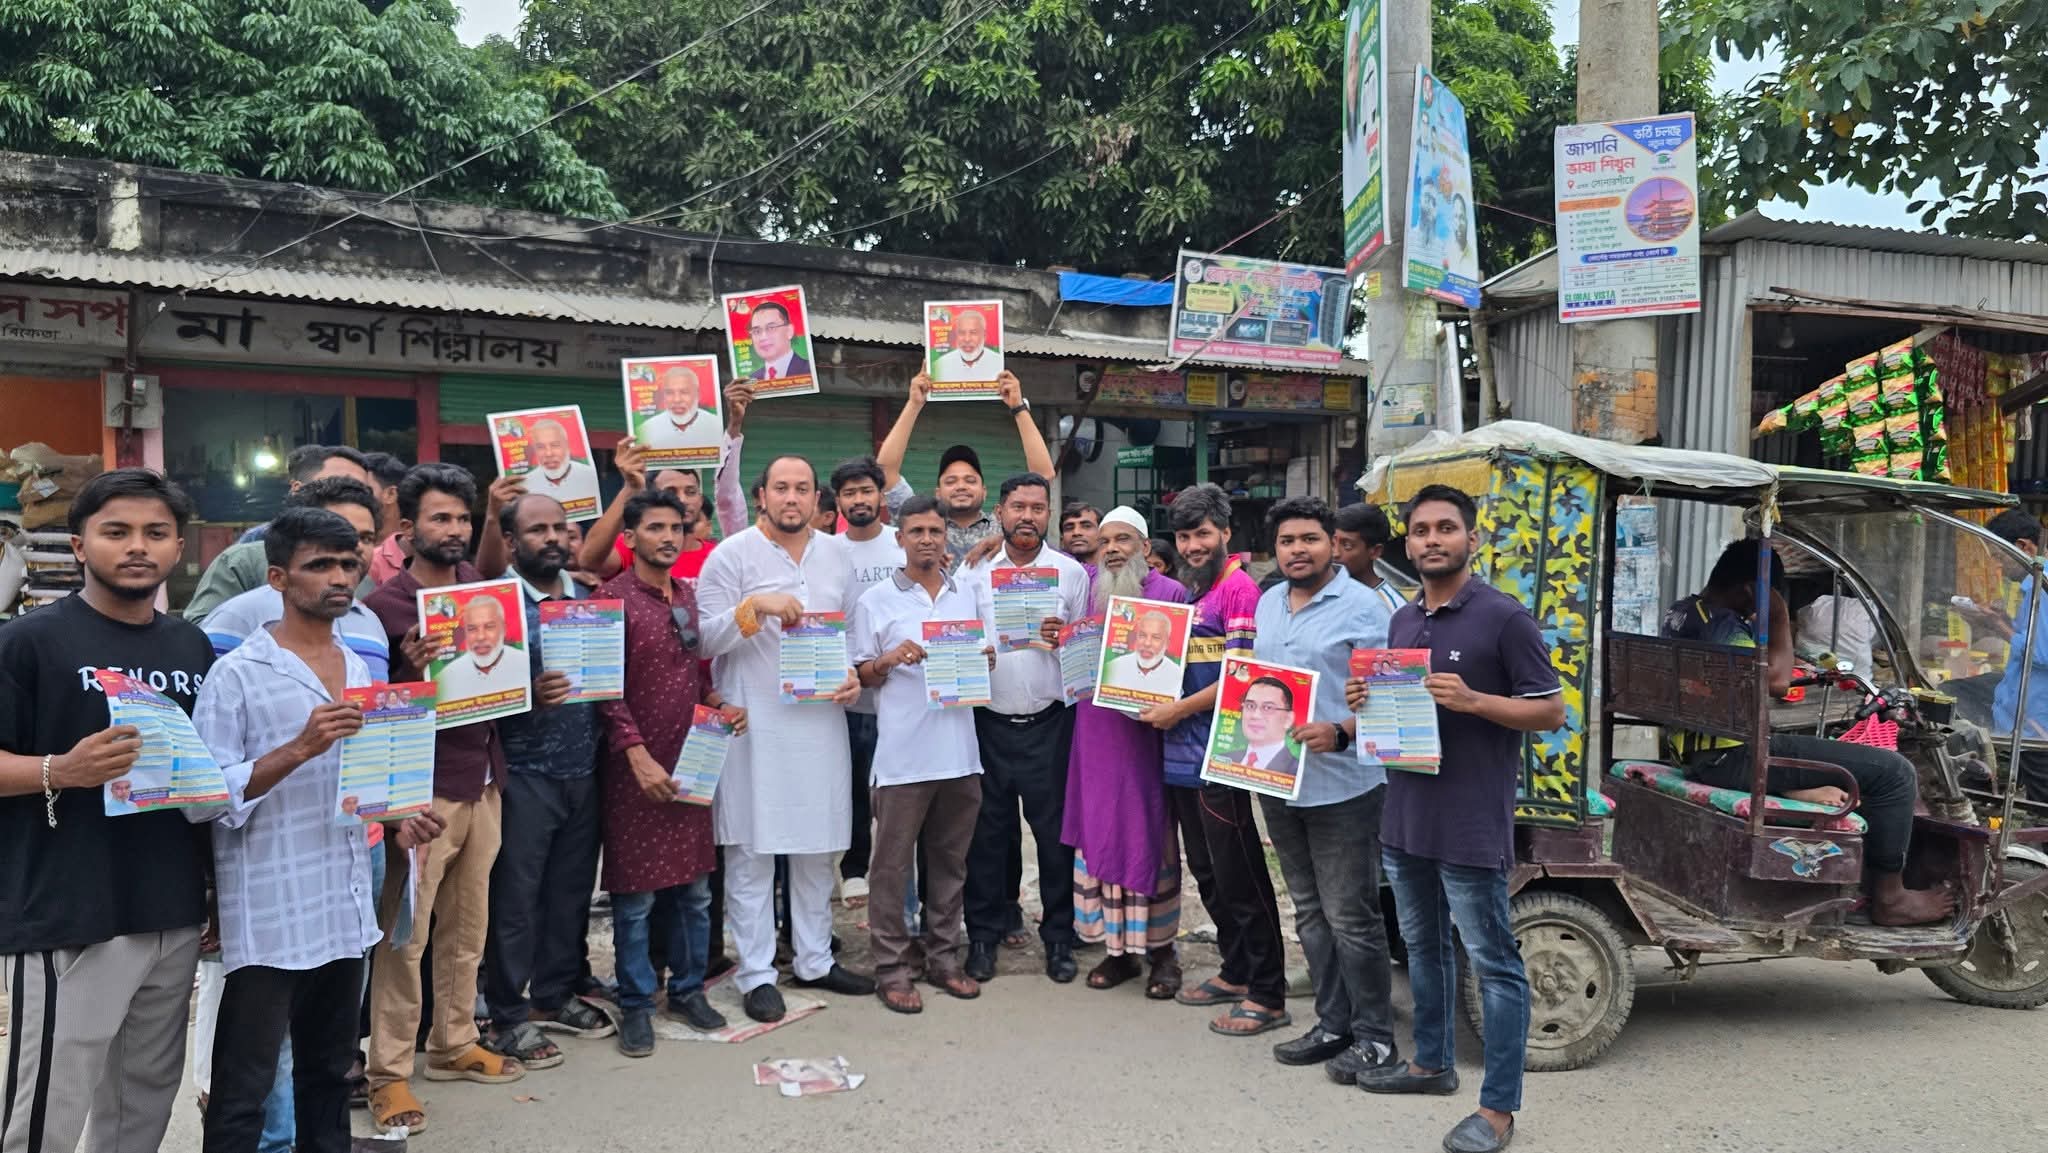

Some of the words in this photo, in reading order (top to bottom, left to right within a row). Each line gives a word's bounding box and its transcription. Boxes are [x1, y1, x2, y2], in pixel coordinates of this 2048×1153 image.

[1564, 134, 1618, 156] জাপানি
[1566, 161, 1596, 174] ভাষা
[1600, 156, 1636, 173] শিখুন
[1594, 289, 1616, 300] VISTA
[171, 308, 265, 351] মা
[306, 317, 386, 355] স্বর্ণ
[399, 318, 562, 368] শিল্পালয়
[78, 666, 203, 695] RNORS
